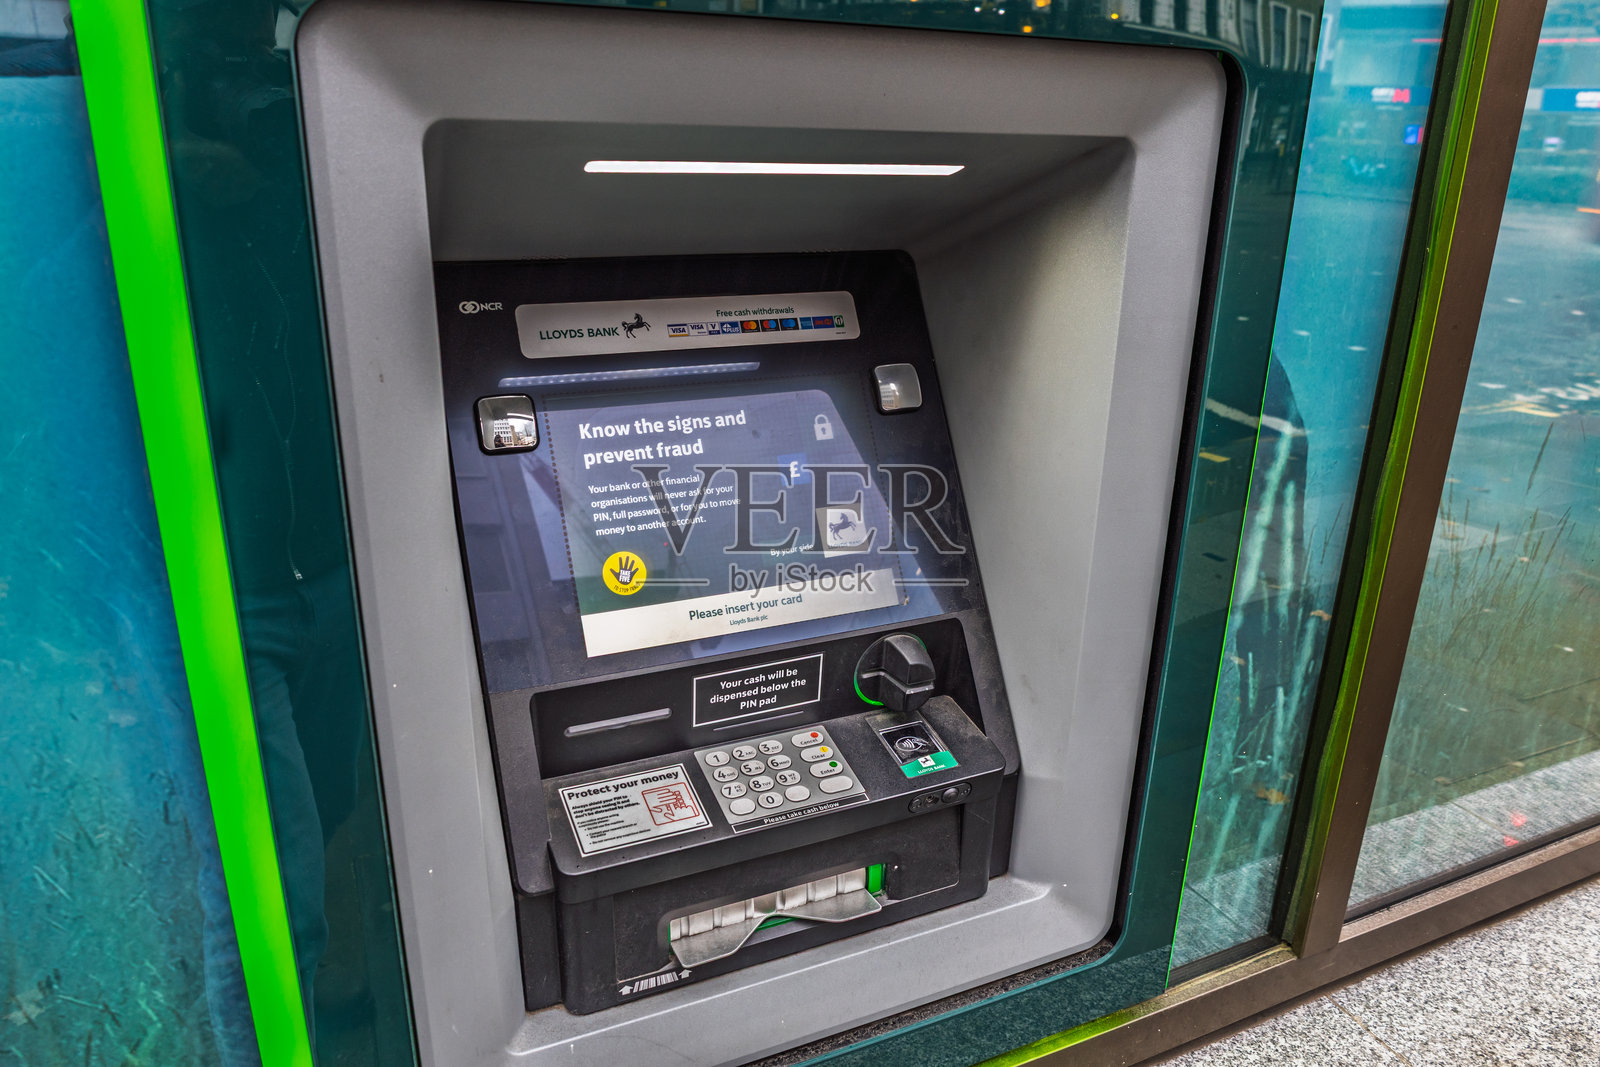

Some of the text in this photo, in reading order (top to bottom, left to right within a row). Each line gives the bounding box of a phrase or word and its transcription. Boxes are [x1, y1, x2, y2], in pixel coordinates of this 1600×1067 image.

[480, 302, 502, 310] NCR
[716, 306, 794, 317] Free cash withdrawals
[540, 326, 620, 340] LLOYDS BANK
[579, 410, 746, 439] Know the signs and
[583, 439, 704, 469] prevent fraud
[790, 461, 800, 478] £
[588, 485, 608, 494] Your
[609, 482, 631, 492] bank
[642, 479, 664, 488] other
[665, 474, 700, 485] financial
[591, 493, 648, 509] organisations
[649, 491, 663, 501] will
[665, 491, 687, 499] never
[688, 487, 702, 497] ask
[715, 485, 733, 496] your
[593, 498, 741, 522] PIN, full password, or for you to move
[595, 516, 706, 536] money to another account.
[770, 544, 813, 558] By your side
[689, 593, 803, 620] Please insert your card
[729, 614, 768, 626] Lloyds Bank plc
[720, 668, 798, 690] Your cash will be
[710, 678, 807, 704] dispensed below the
[740, 695, 777, 709] PIN pad
[736, 750, 744, 758] 2
[761, 744, 770, 752] 3
[713, 754, 720, 763] 1
[770, 759, 780, 767] 6
[718, 770, 727, 779] 4
[743, 764, 752, 773] 5
[752, 780, 761, 788] 8
[779, 774, 787, 782] 9
[567, 771, 679, 800] Protect your money
[724, 786, 731, 795] 7
[763, 802, 840, 824] Please take cash below
